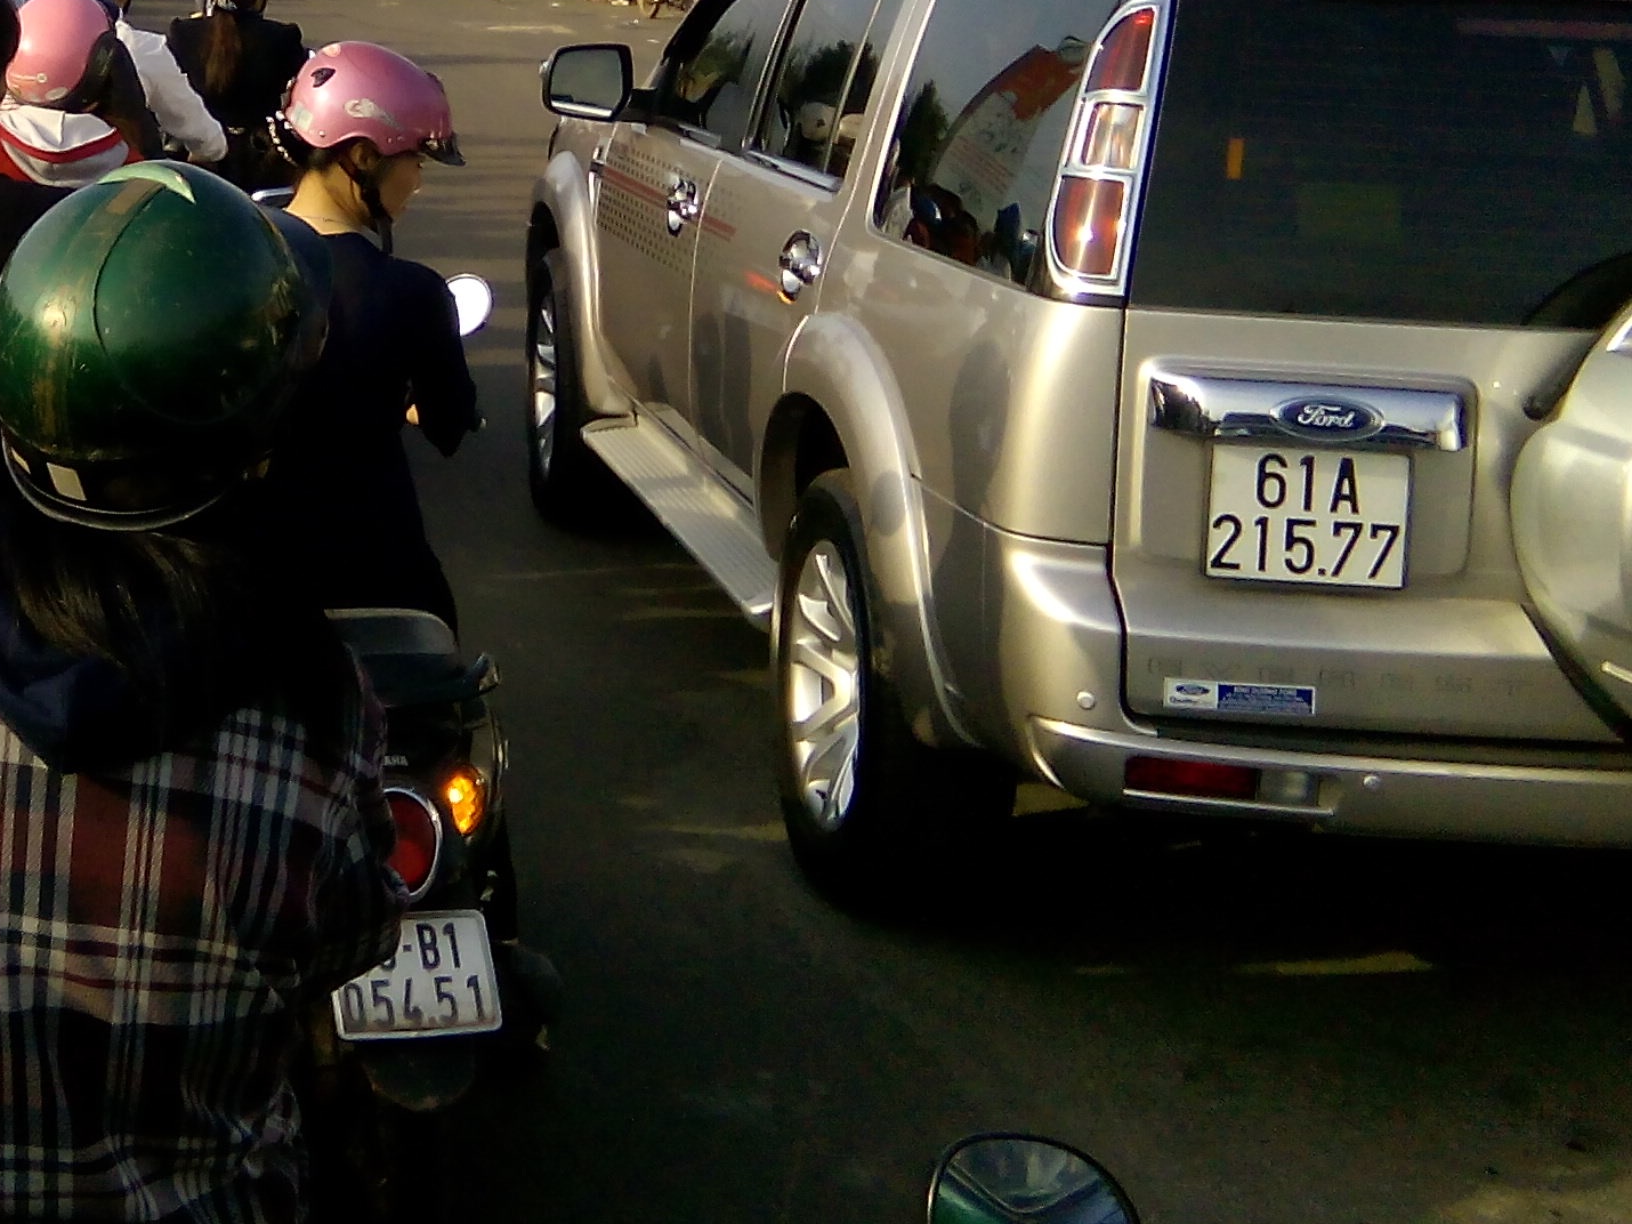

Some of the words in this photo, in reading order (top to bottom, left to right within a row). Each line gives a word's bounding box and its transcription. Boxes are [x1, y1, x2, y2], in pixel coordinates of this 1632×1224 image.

[1297, 404, 1355, 428] Ford
[1255, 452, 1360, 515] 61A
[1210, 515, 1401, 580] 215.77
